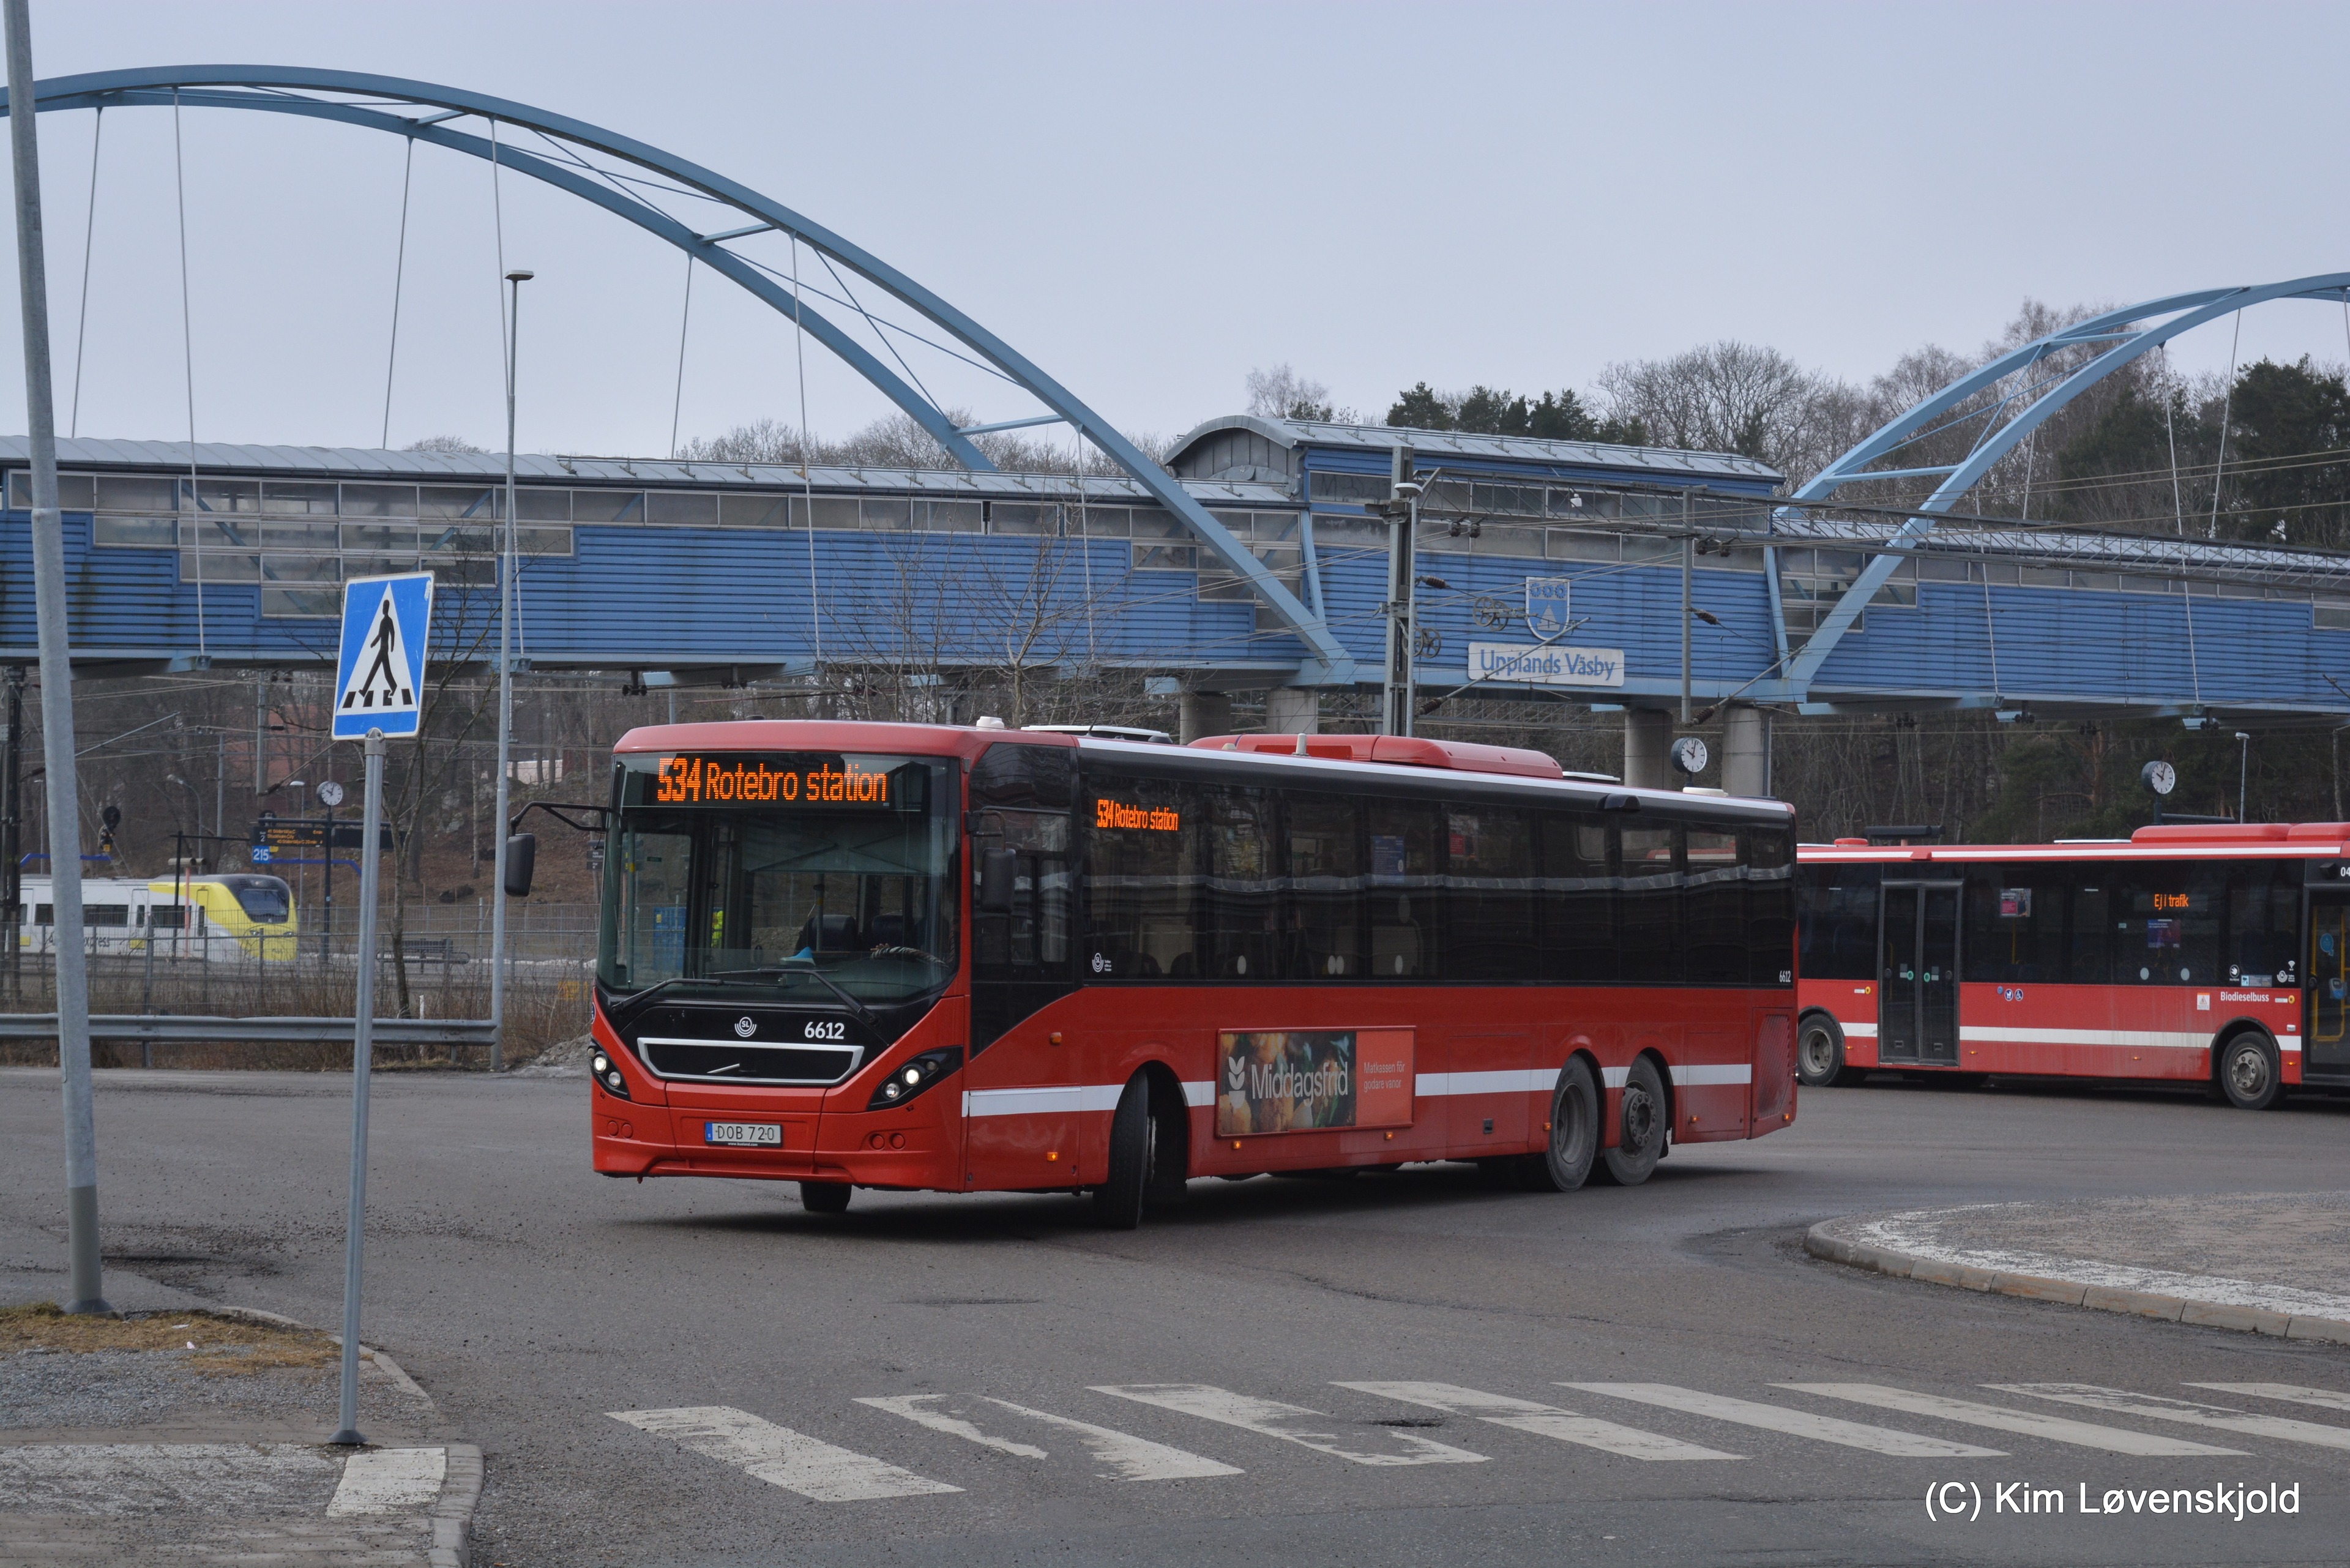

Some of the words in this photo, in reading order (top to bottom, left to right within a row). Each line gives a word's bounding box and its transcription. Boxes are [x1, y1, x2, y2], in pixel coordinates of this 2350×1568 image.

[1480, 649, 1561, 676] Upplands
[1565, 653, 1615, 681] Väsby
[657, 758, 701, 801] 534
[706, 763, 798, 801] Rotebro
[806, 763, 887, 801] station
[1097, 799, 1114, 827] 534
[1114, 803, 1148, 829] Rotebro
[1150, 807, 1178, 831] station
[253, 848, 269, 861] 215
[2155, 894, 2162, 910] Ej
[2164, 894, 2166, 907] i
[2168, 894, 2189, 907] trafik
[1779, 970, 1791, 982] 6612
[2220, 991, 2269, 1002] Biodieselbuss
[804, 1021, 845, 1040] 6612
[1363, 1062, 1395, 1073] Matkassen
[1397, 1061, 1406, 1072] för
[1251, 1062, 1348, 1106] Middagsfrid
[1363, 1078, 1384, 1092] godare
[1386, 1080, 1402, 1088] vanor
[717, 1125, 743, 1140] DOB
[748, 1126, 774, 1140] 720
